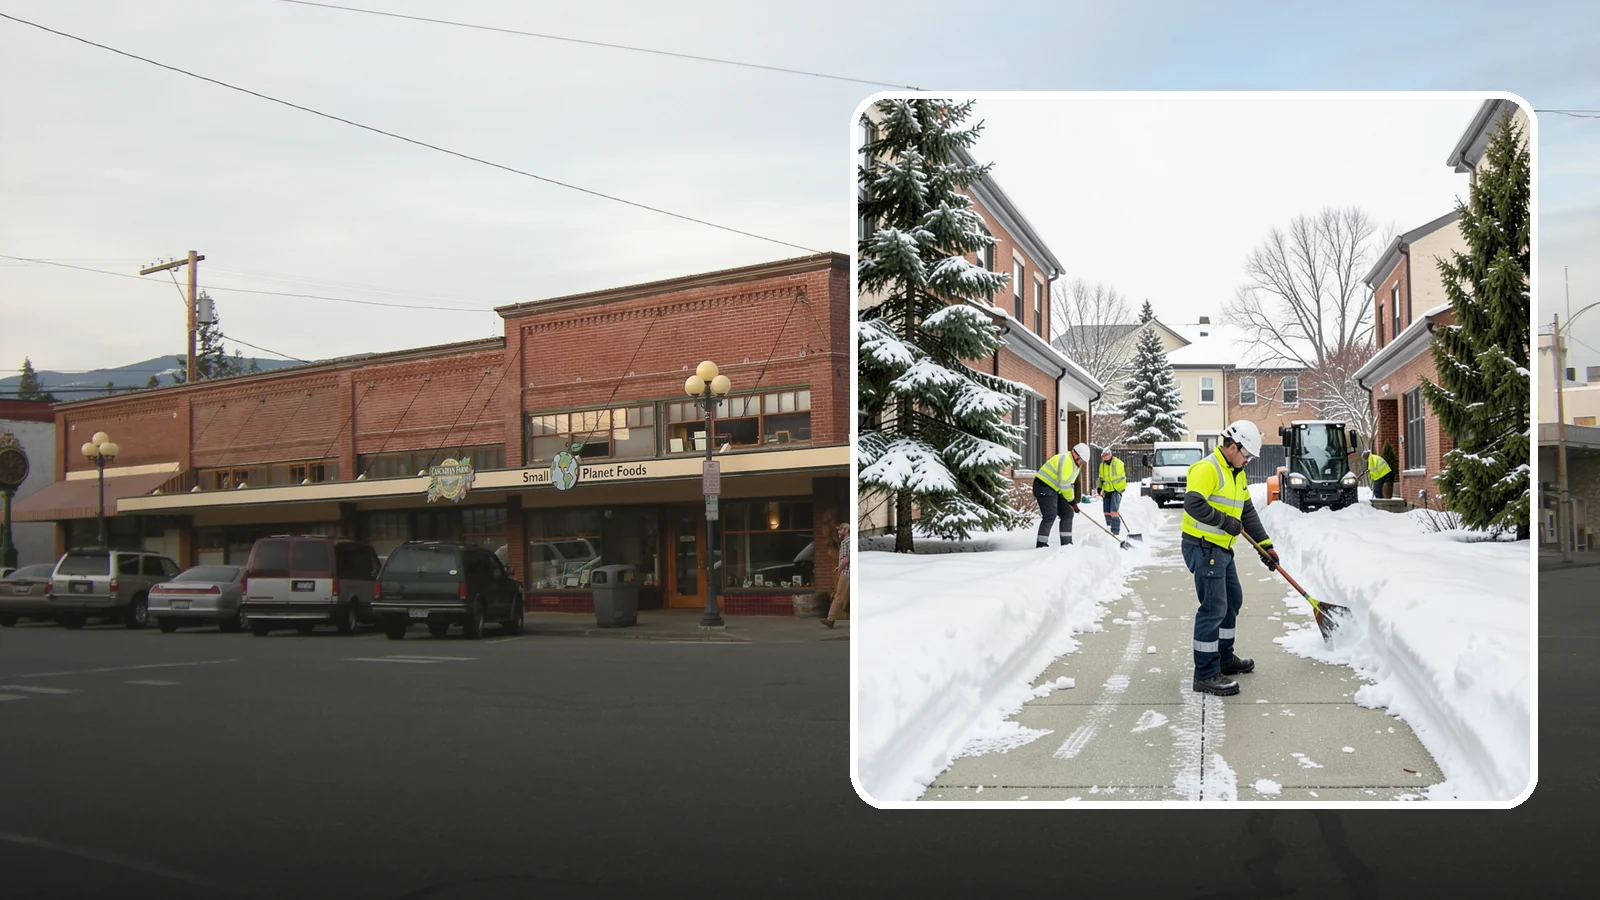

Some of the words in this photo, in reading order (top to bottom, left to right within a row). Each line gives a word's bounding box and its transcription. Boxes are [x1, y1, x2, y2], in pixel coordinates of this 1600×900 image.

[523, 471, 549, 483] Small
[583, 467, 614, 479] Planet
[617, 464, 647, 477] Foods
